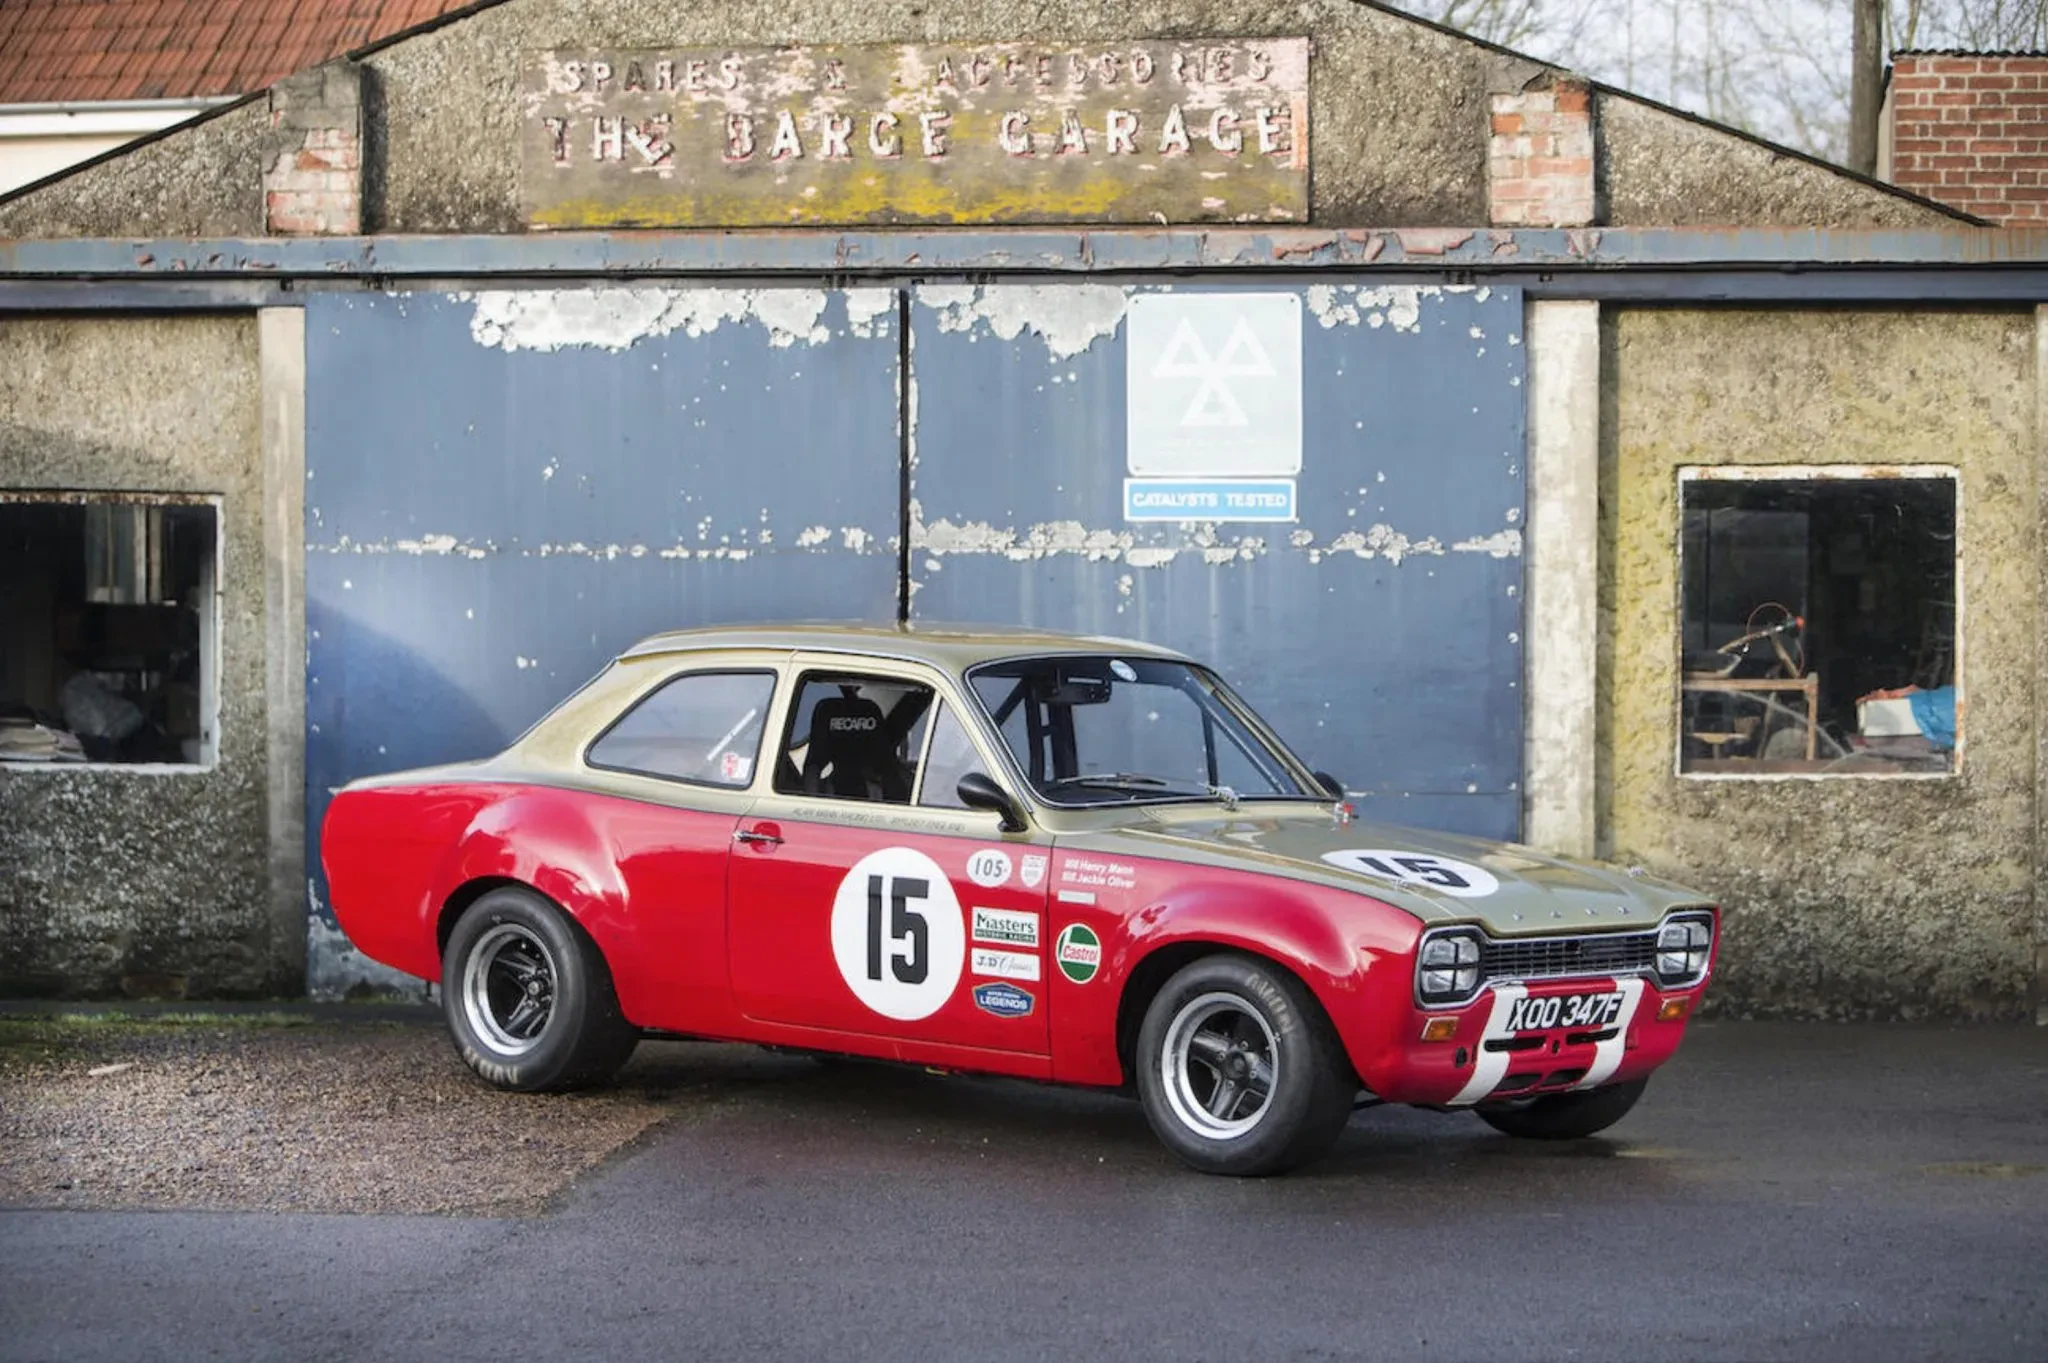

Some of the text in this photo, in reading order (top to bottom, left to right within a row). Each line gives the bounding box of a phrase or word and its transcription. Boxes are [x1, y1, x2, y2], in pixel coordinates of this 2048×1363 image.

[561, 58, 744, 93] SPARES
[542, 103, 1295, 166] THE BARGE GARAGE
[1132, 492, 1288, 508] CATALYSTS TESTED
[830, 716, 878, 732] RECARO
[1355, 856, 1471, 888] 15
[867, 874, 930, 985] 15
[976, 912, 1035, 934] Masters
[1063, 945, 1099, 962] Castrol
[980, 995, 1028, 1010] LEGENDS
[1507, 991, 1623, 1031] XOO 347F
